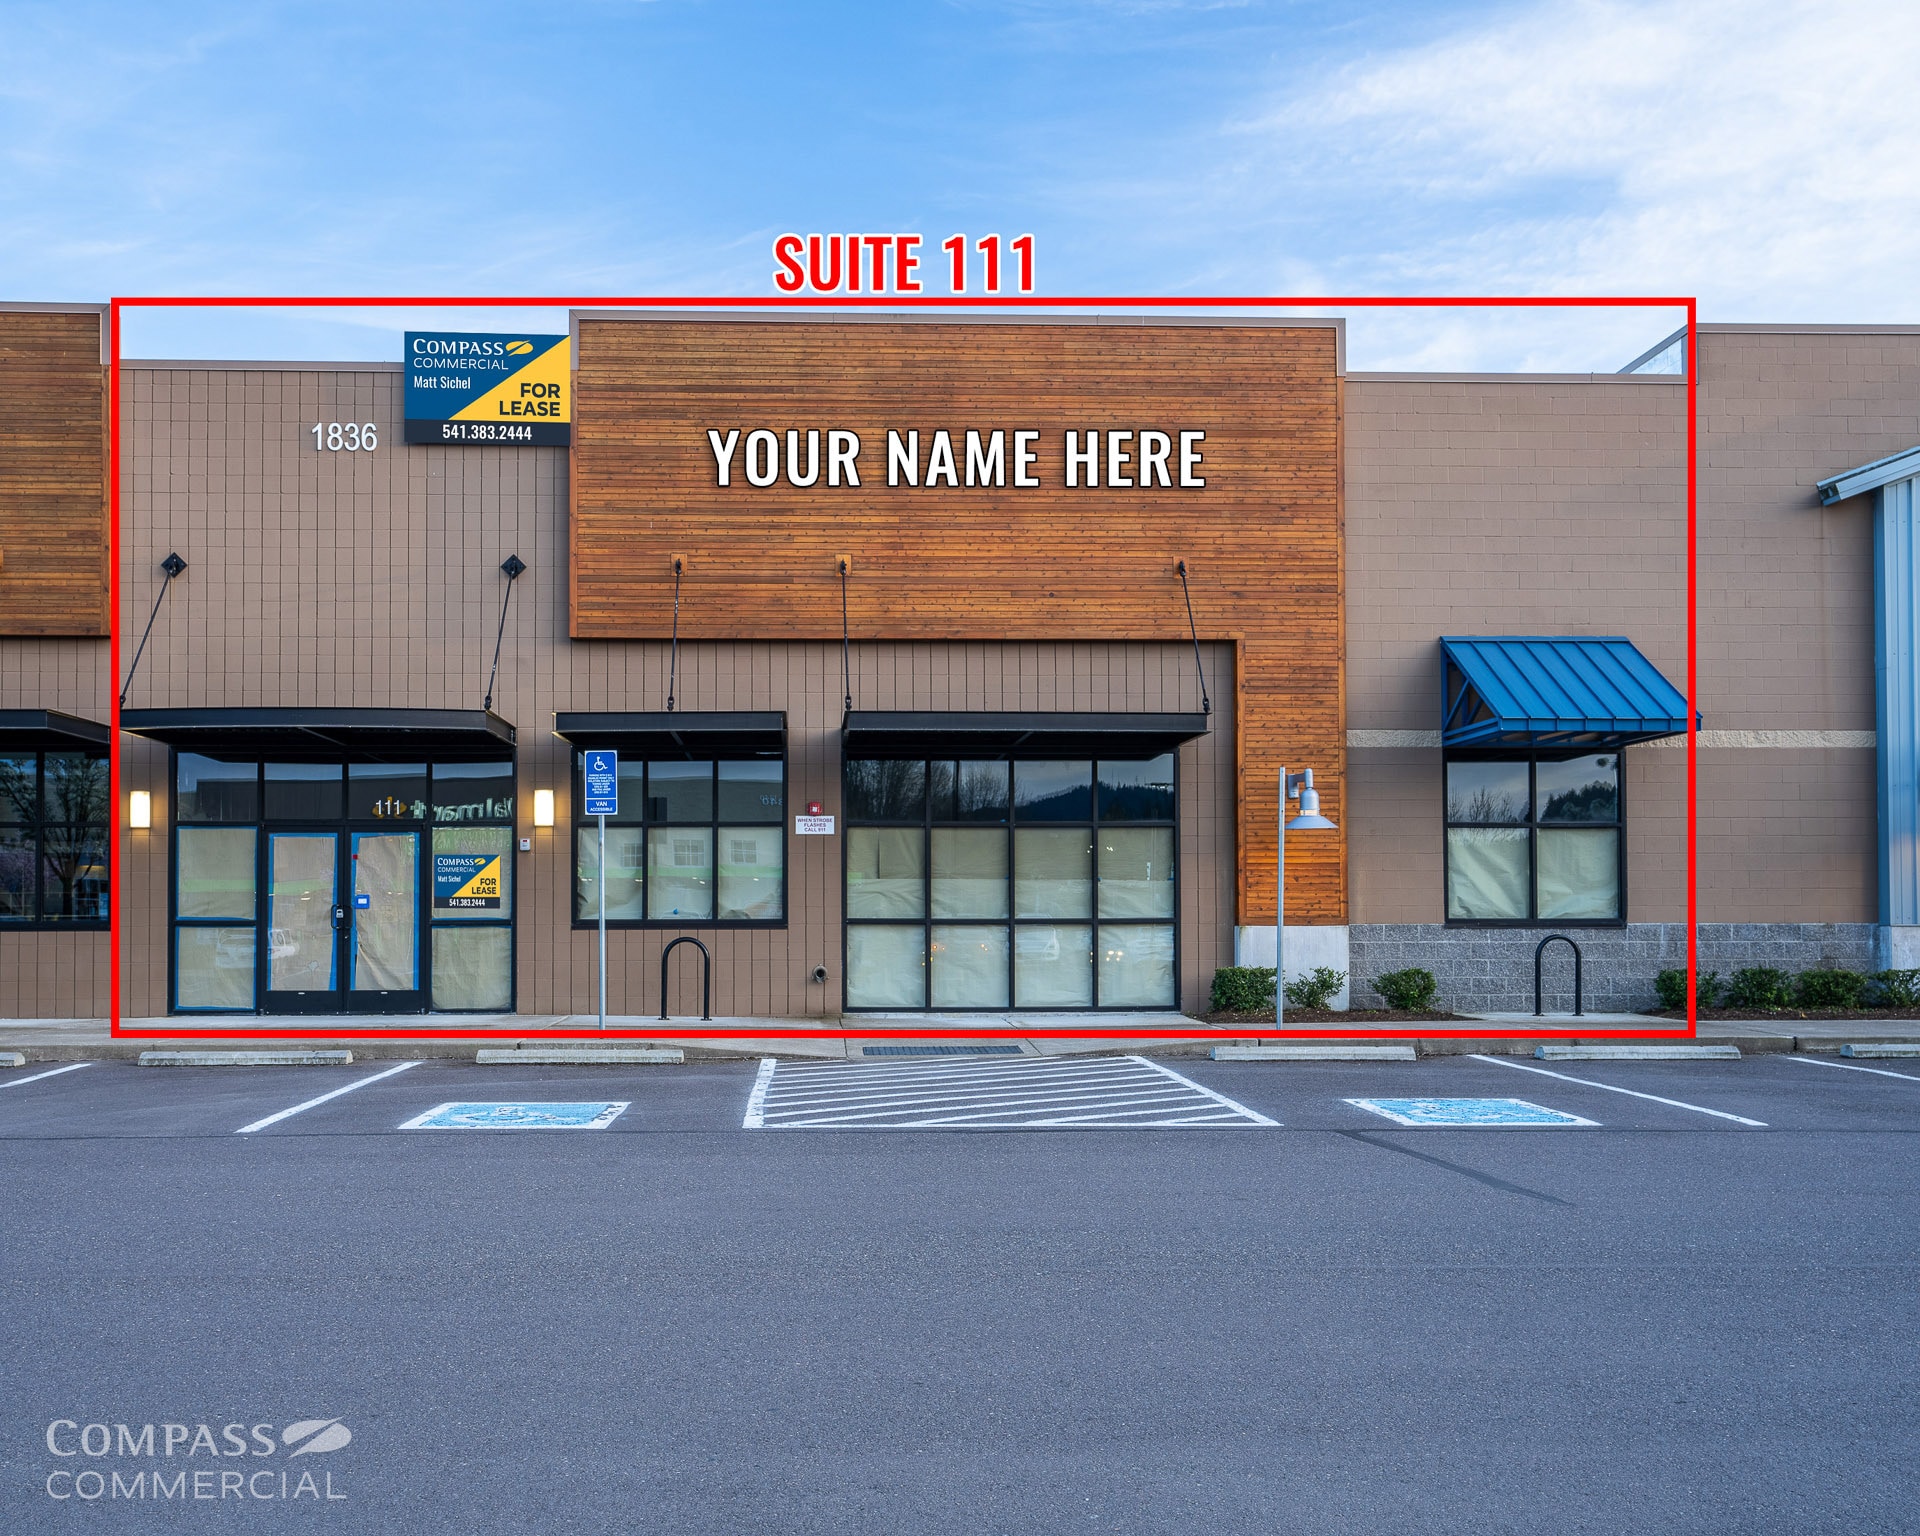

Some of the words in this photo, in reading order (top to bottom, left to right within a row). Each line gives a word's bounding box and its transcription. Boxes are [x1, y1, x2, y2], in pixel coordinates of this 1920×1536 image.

[413, 338, 504, 356] COMPASS
[413, 357, 509, 370] COMMERCIAL
[414, 375, 437, 389] Matt
[440, 376, 471, 390] Sichel
[520, 383, 561, 399] FOR
[499, 400, 561, 416] LEASE
[311, 422, 378, 451] 1836
[442, 424, 532, 440] 541.383.2444
[375, 799, 401, 815] 111
[437, 857, 474, 866] COMPASS
[480, 878, 497, 886] FOR
[471, 887, 497, 895] LEASE
[449, 898, 486, 907] 541.383.2444
